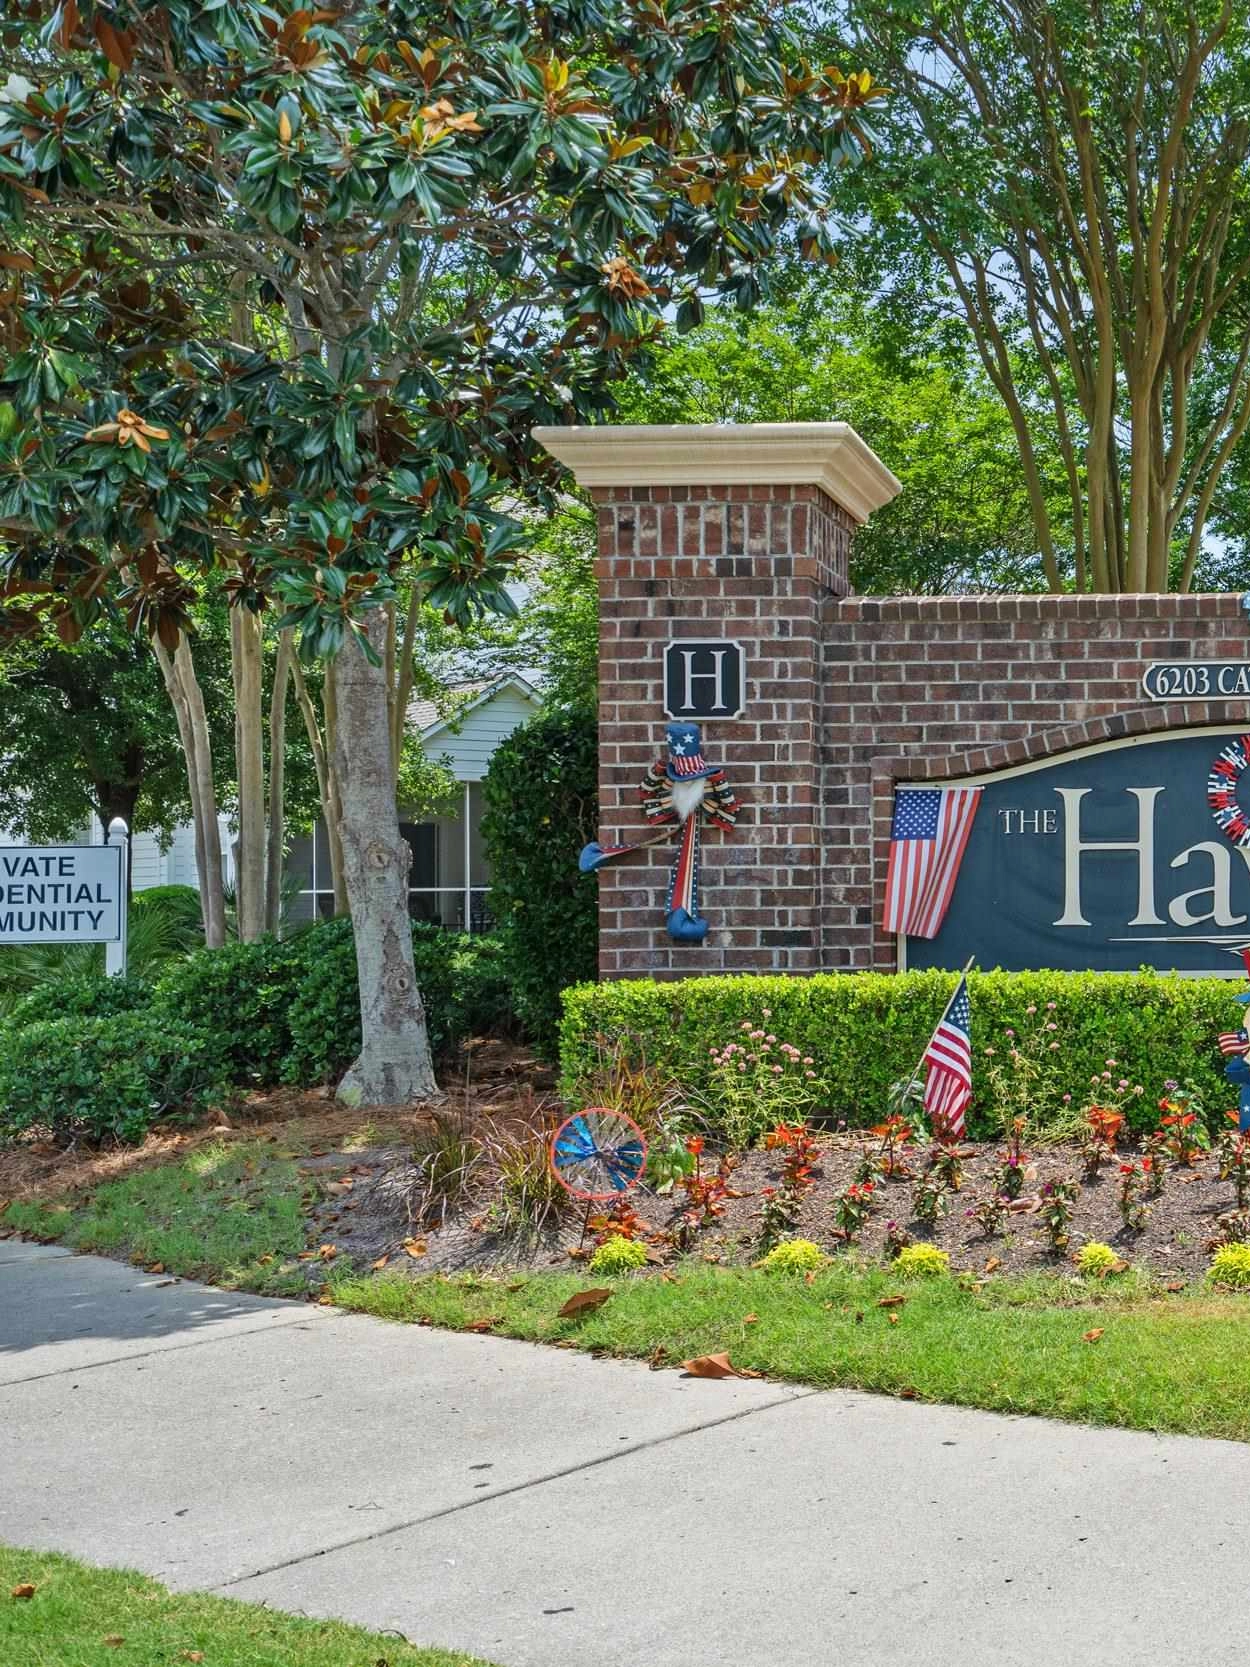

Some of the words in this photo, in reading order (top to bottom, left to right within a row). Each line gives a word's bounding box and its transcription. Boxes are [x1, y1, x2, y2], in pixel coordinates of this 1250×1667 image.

[680, 650, 728, 710] H
[1156, 667, 1210, 696] 6203
[999, 808, 1057, 835] THE
[3, 856, 75, 877] VATE
[0, 883, 112, 905] ENTIAL
